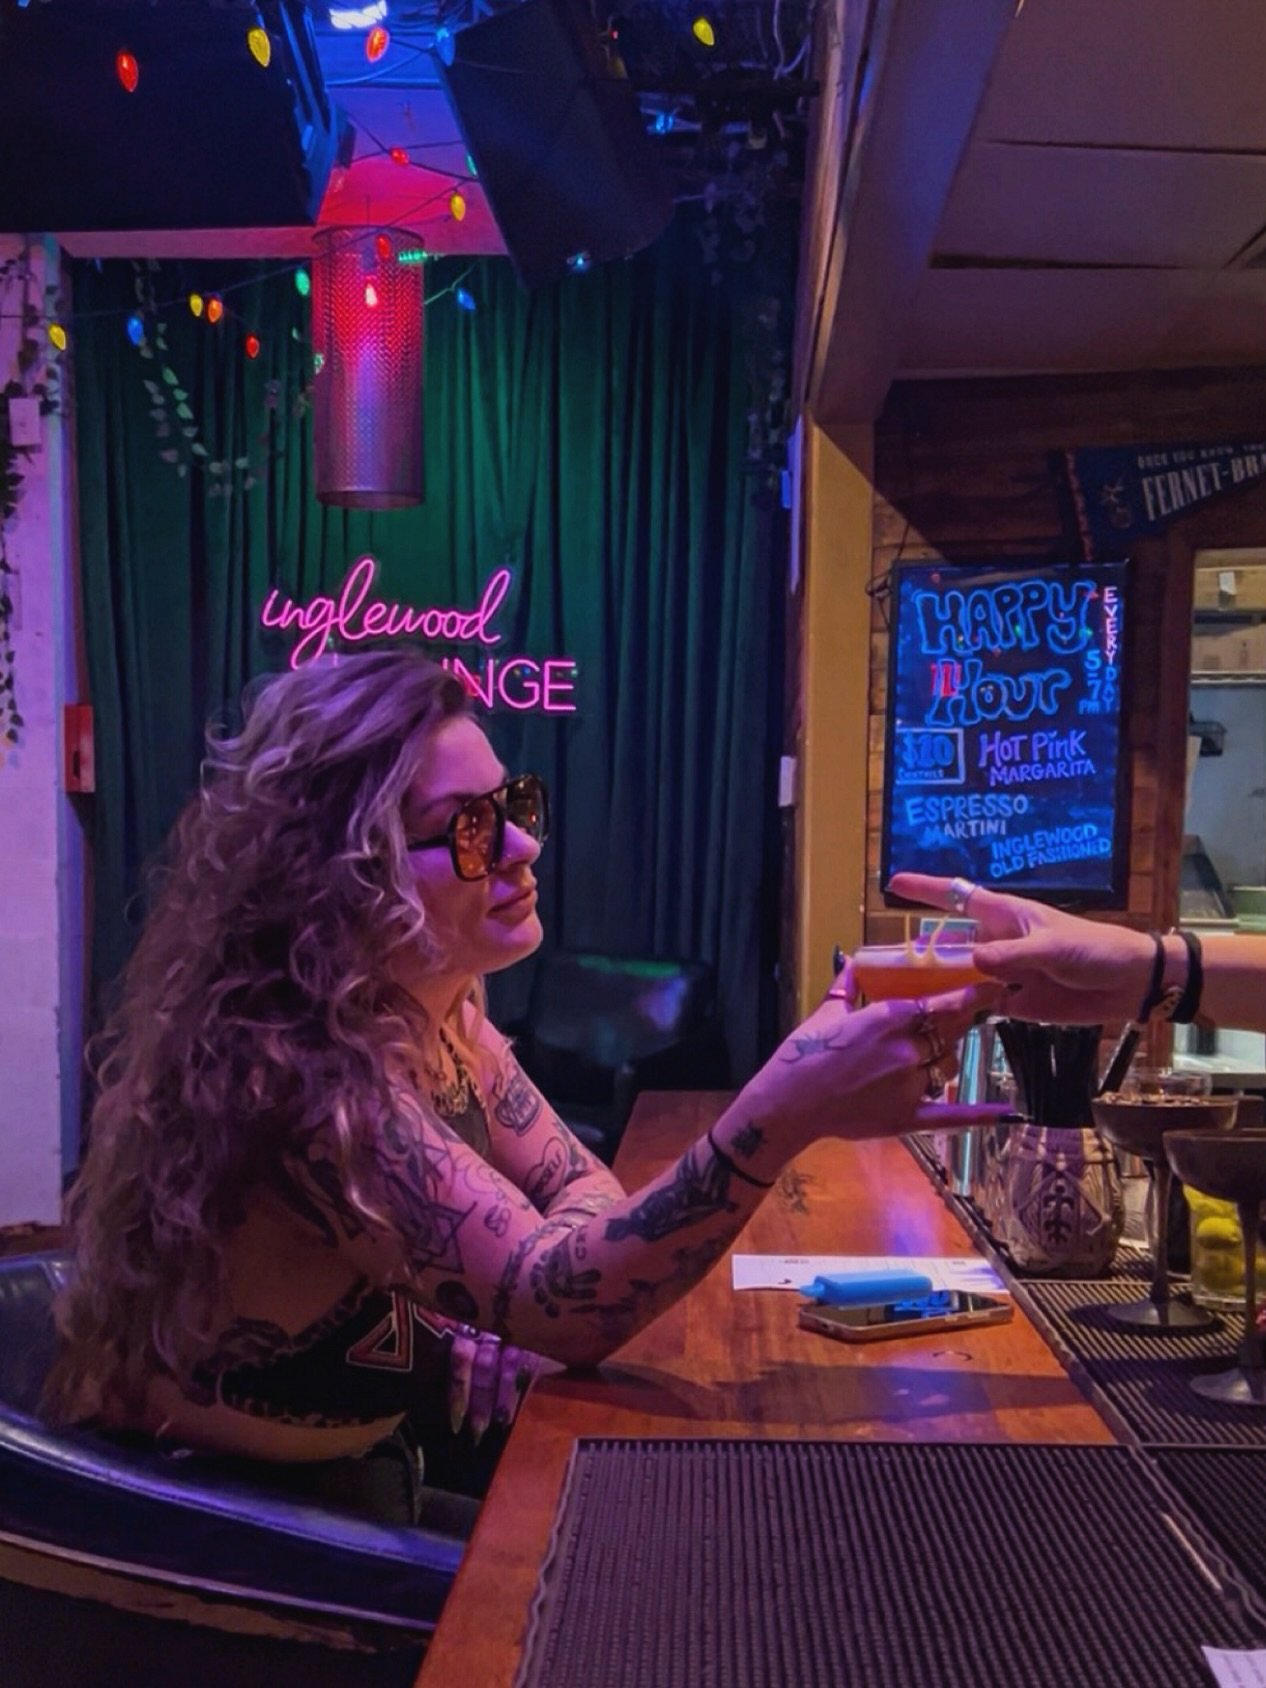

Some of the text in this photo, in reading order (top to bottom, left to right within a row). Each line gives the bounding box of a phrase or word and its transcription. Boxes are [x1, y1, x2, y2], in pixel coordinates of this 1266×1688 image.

[911, 579, 1097, 655] HAPPY
[902, 731, 955, 769] $10
[989, 759, 1096, 786] MARGARITA
[905, 793, 1030, 827] ESPRESSO
[918, 819, 1008, 847] MARTINI
[991, 823, 1099, 860] INGLEWOOD
[989, 838, 1113, 879] OLD FASHIONED
